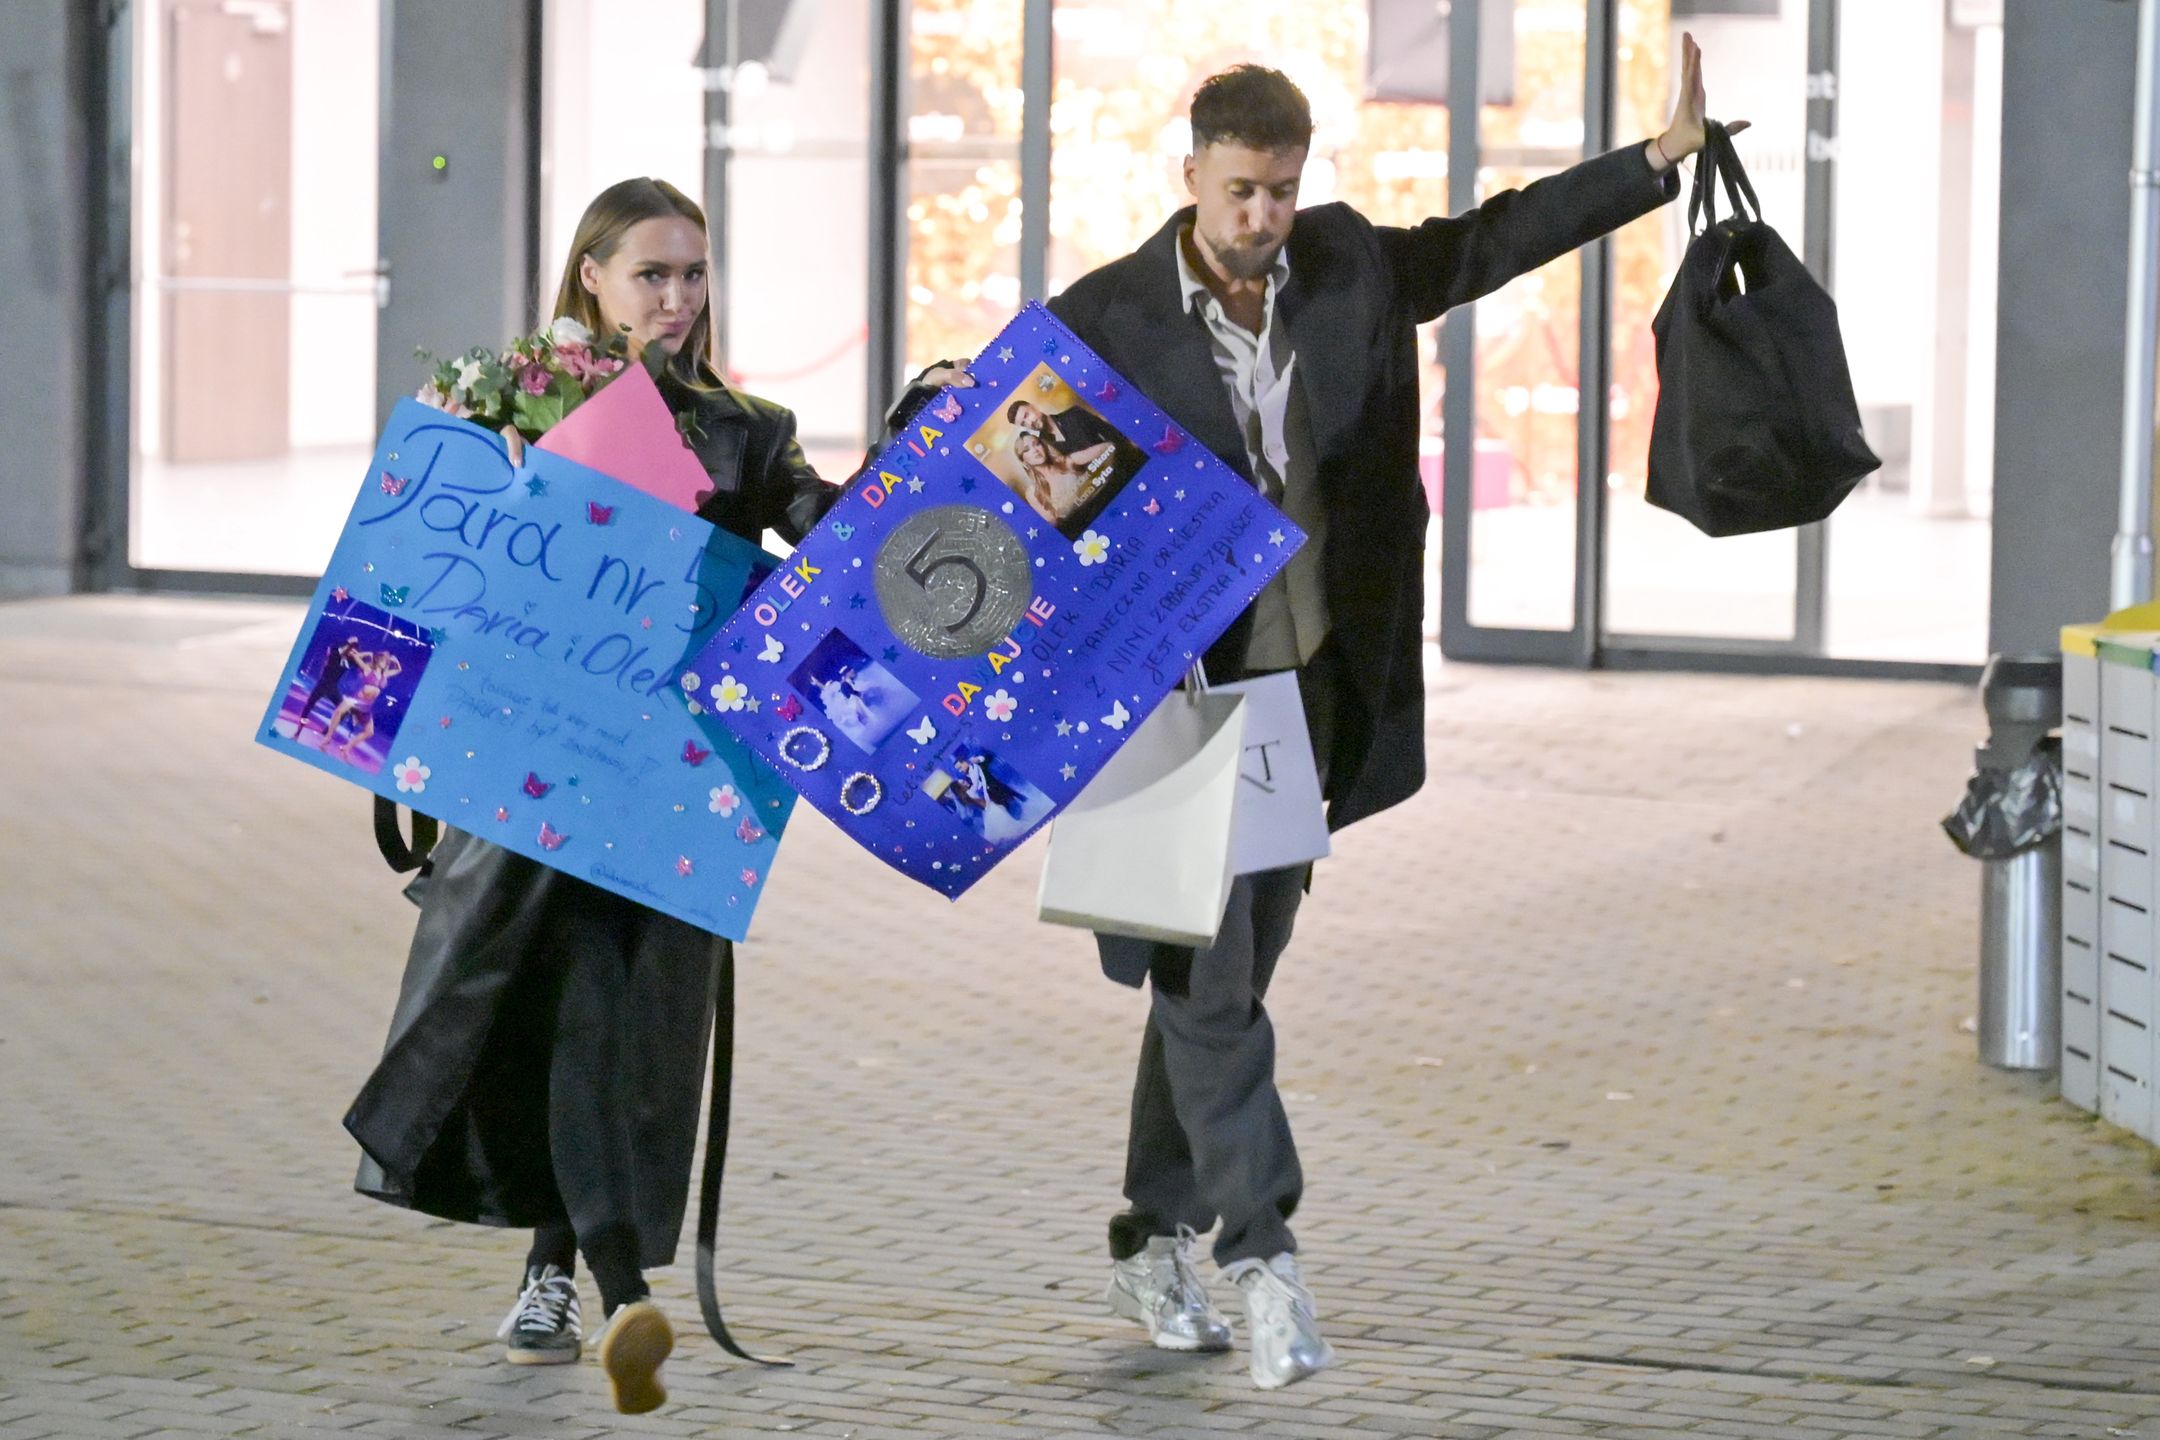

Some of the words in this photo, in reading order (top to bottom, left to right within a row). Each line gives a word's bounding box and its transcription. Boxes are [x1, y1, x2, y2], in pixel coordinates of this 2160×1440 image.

[1087, 444, 1116, 473] Sikora
[1092, 465, 1114, 487] Syta
[359, 424, 562, 582] Para
[588, 554, 664, 617] nr
[675, 546, 737, 633] 5
[754, 556, 822, 627] OLEK
[831, 521, 855, 541] &
[861, 425, 944, 509] DARIA
[1154, 491, 1228, 570] ORKIESTRA
[903, 527, 987, 634] 5
[1031, 609, 1080, 662] OLEK
[1091, 536, 1145, 592] DARIA
[583, 633, 682, 708] Olek
[942, 596, 1056, 717] DAWAJCIE
[1142, 635, 1175, 686] JEST
